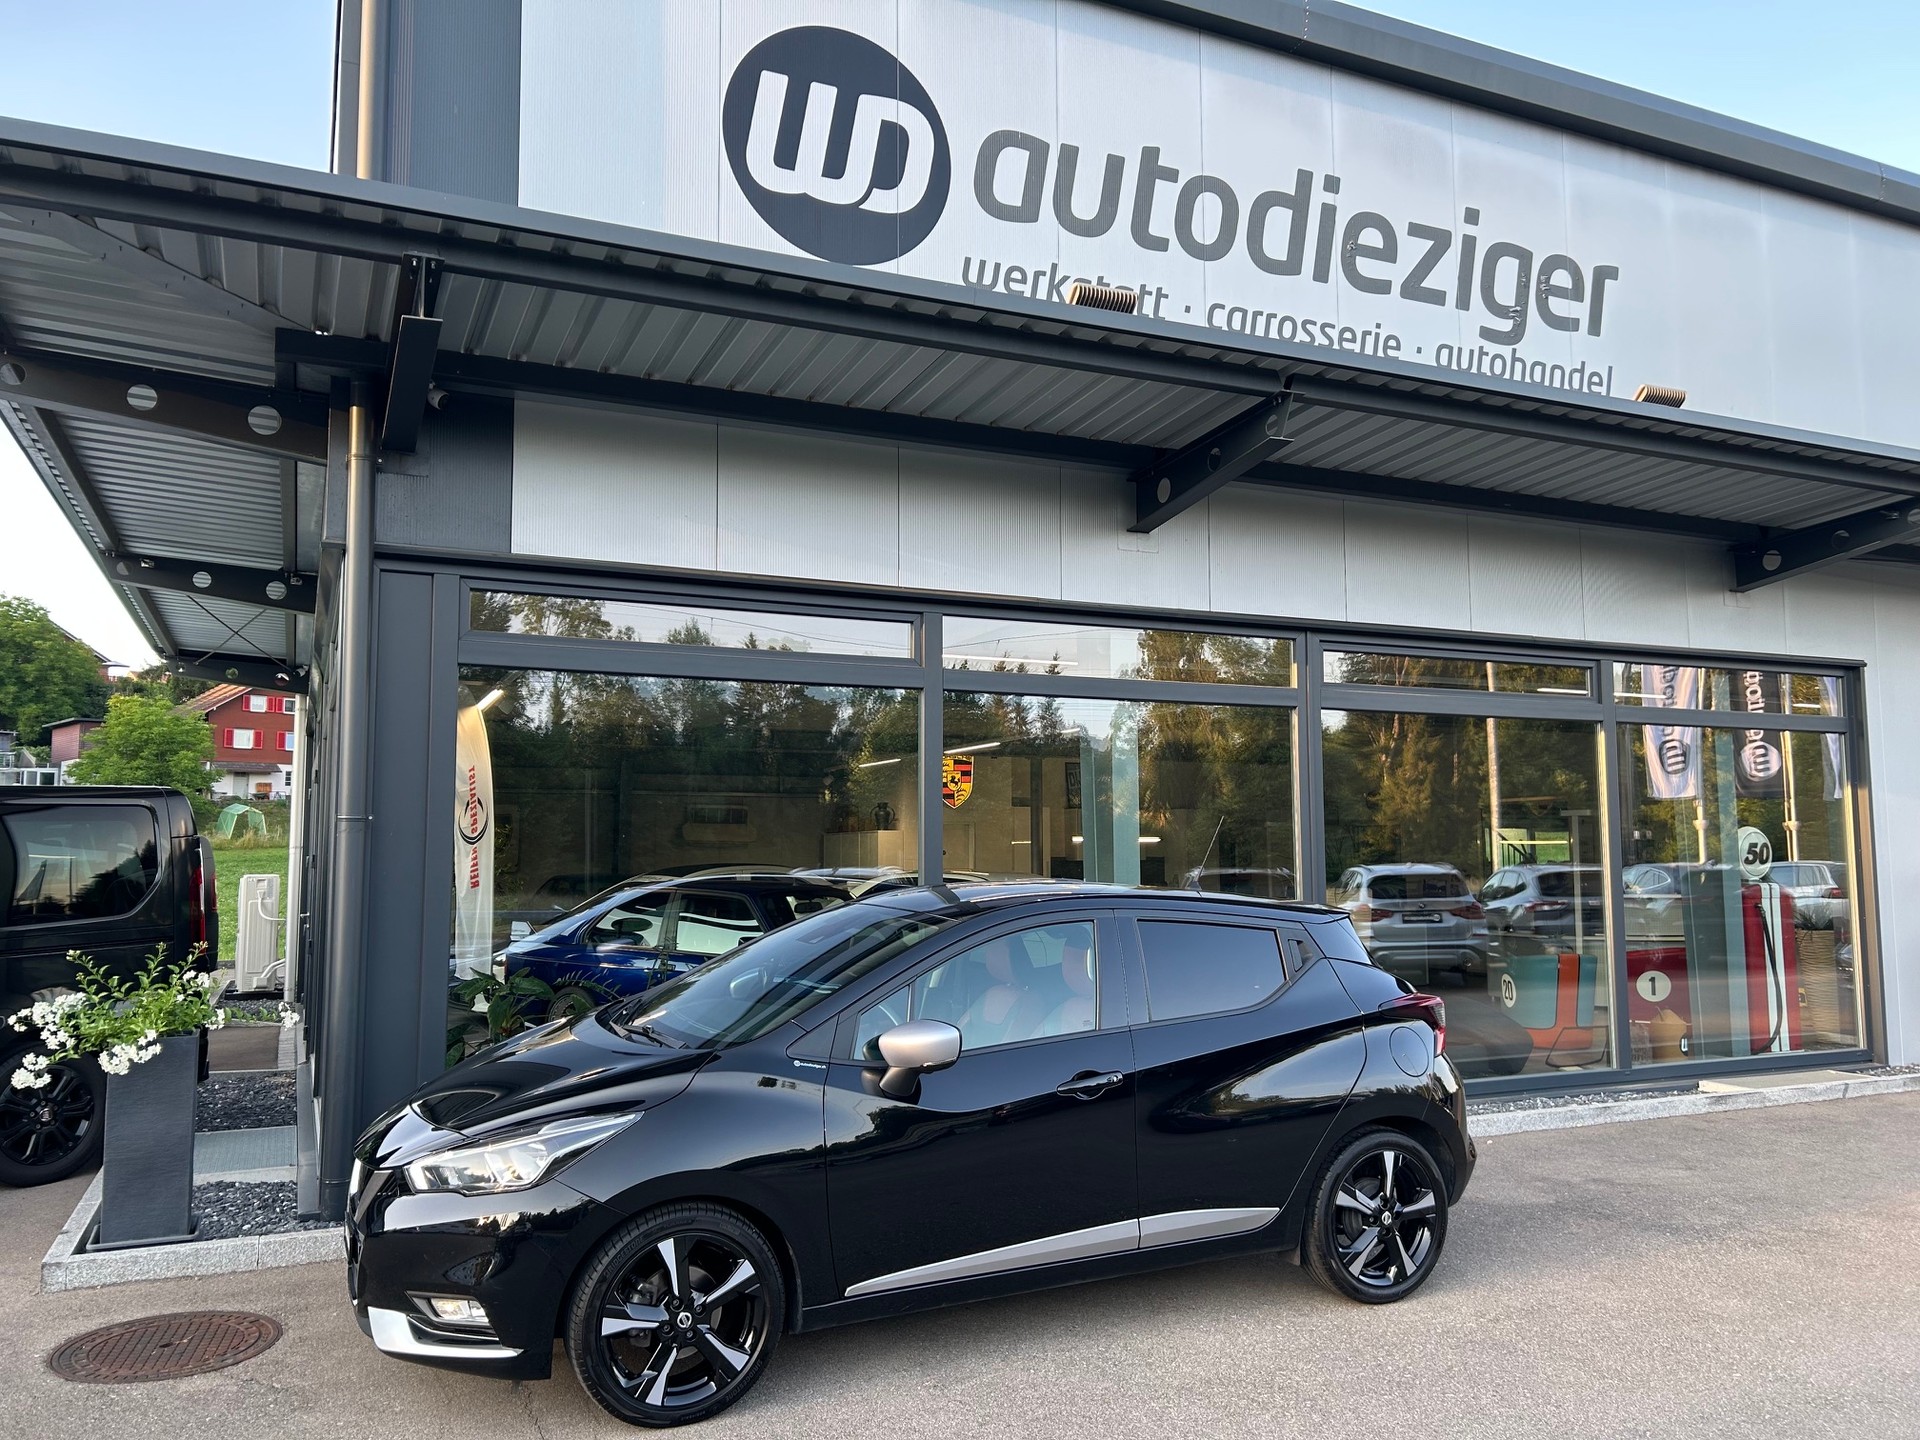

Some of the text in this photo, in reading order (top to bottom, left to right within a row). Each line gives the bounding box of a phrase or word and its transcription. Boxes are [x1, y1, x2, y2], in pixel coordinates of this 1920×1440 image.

[973, 129, 1619, 346] autodieziger
[962, 256, 1613, 397] werktt carrosserie autohandel
[1744, 842, 1770, 866] 50
[1502, 979, 1514, 1001] 20
[1648, 976, 1657, 996] 1
